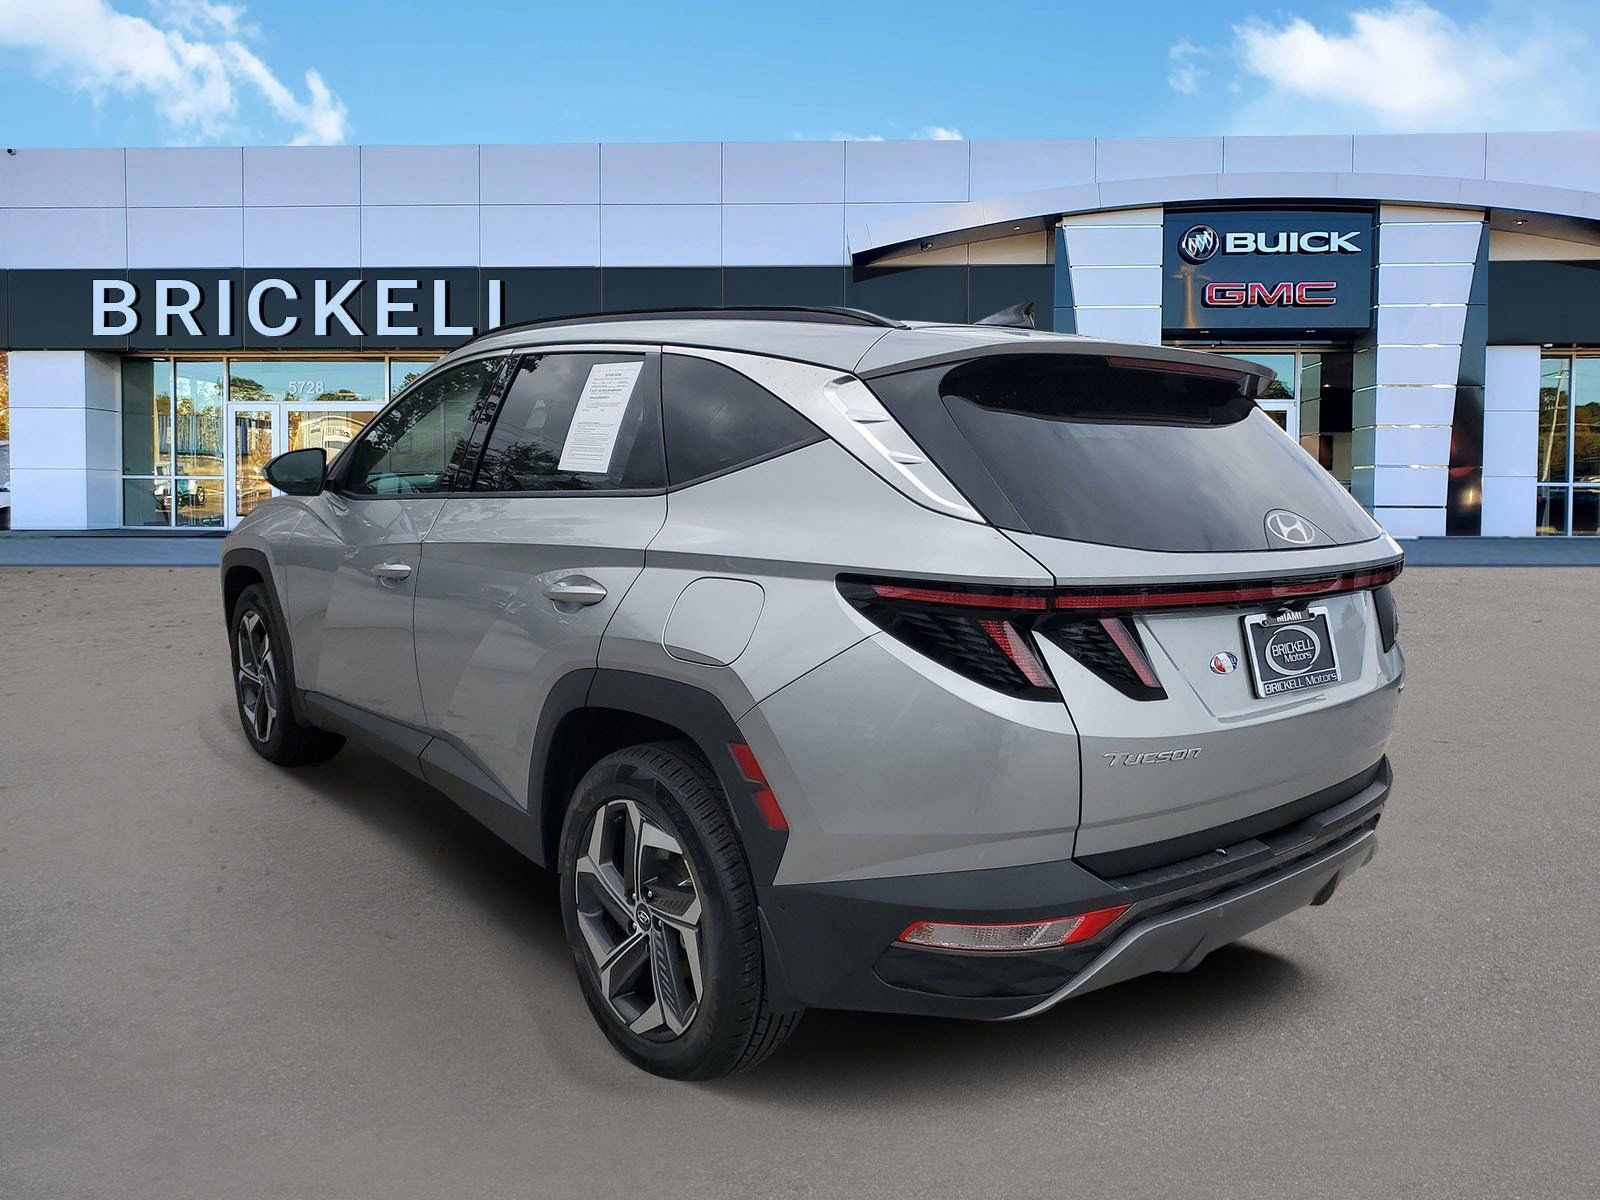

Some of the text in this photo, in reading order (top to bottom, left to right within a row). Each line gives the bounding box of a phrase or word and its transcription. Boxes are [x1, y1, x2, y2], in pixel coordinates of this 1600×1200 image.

[1225, 231, 1362, 253] BUICK
[1205, 282, 1337, 305] GMC
[288, 381, 325, 395] 5728
[1276, 612, 1302, 622] MIAMI
[1271, 639, 1314, 656] BRICKELL
[1284, 652, 1312, 663] Motors
[1265, 672, 1337, 694] BRICKELL Motors
